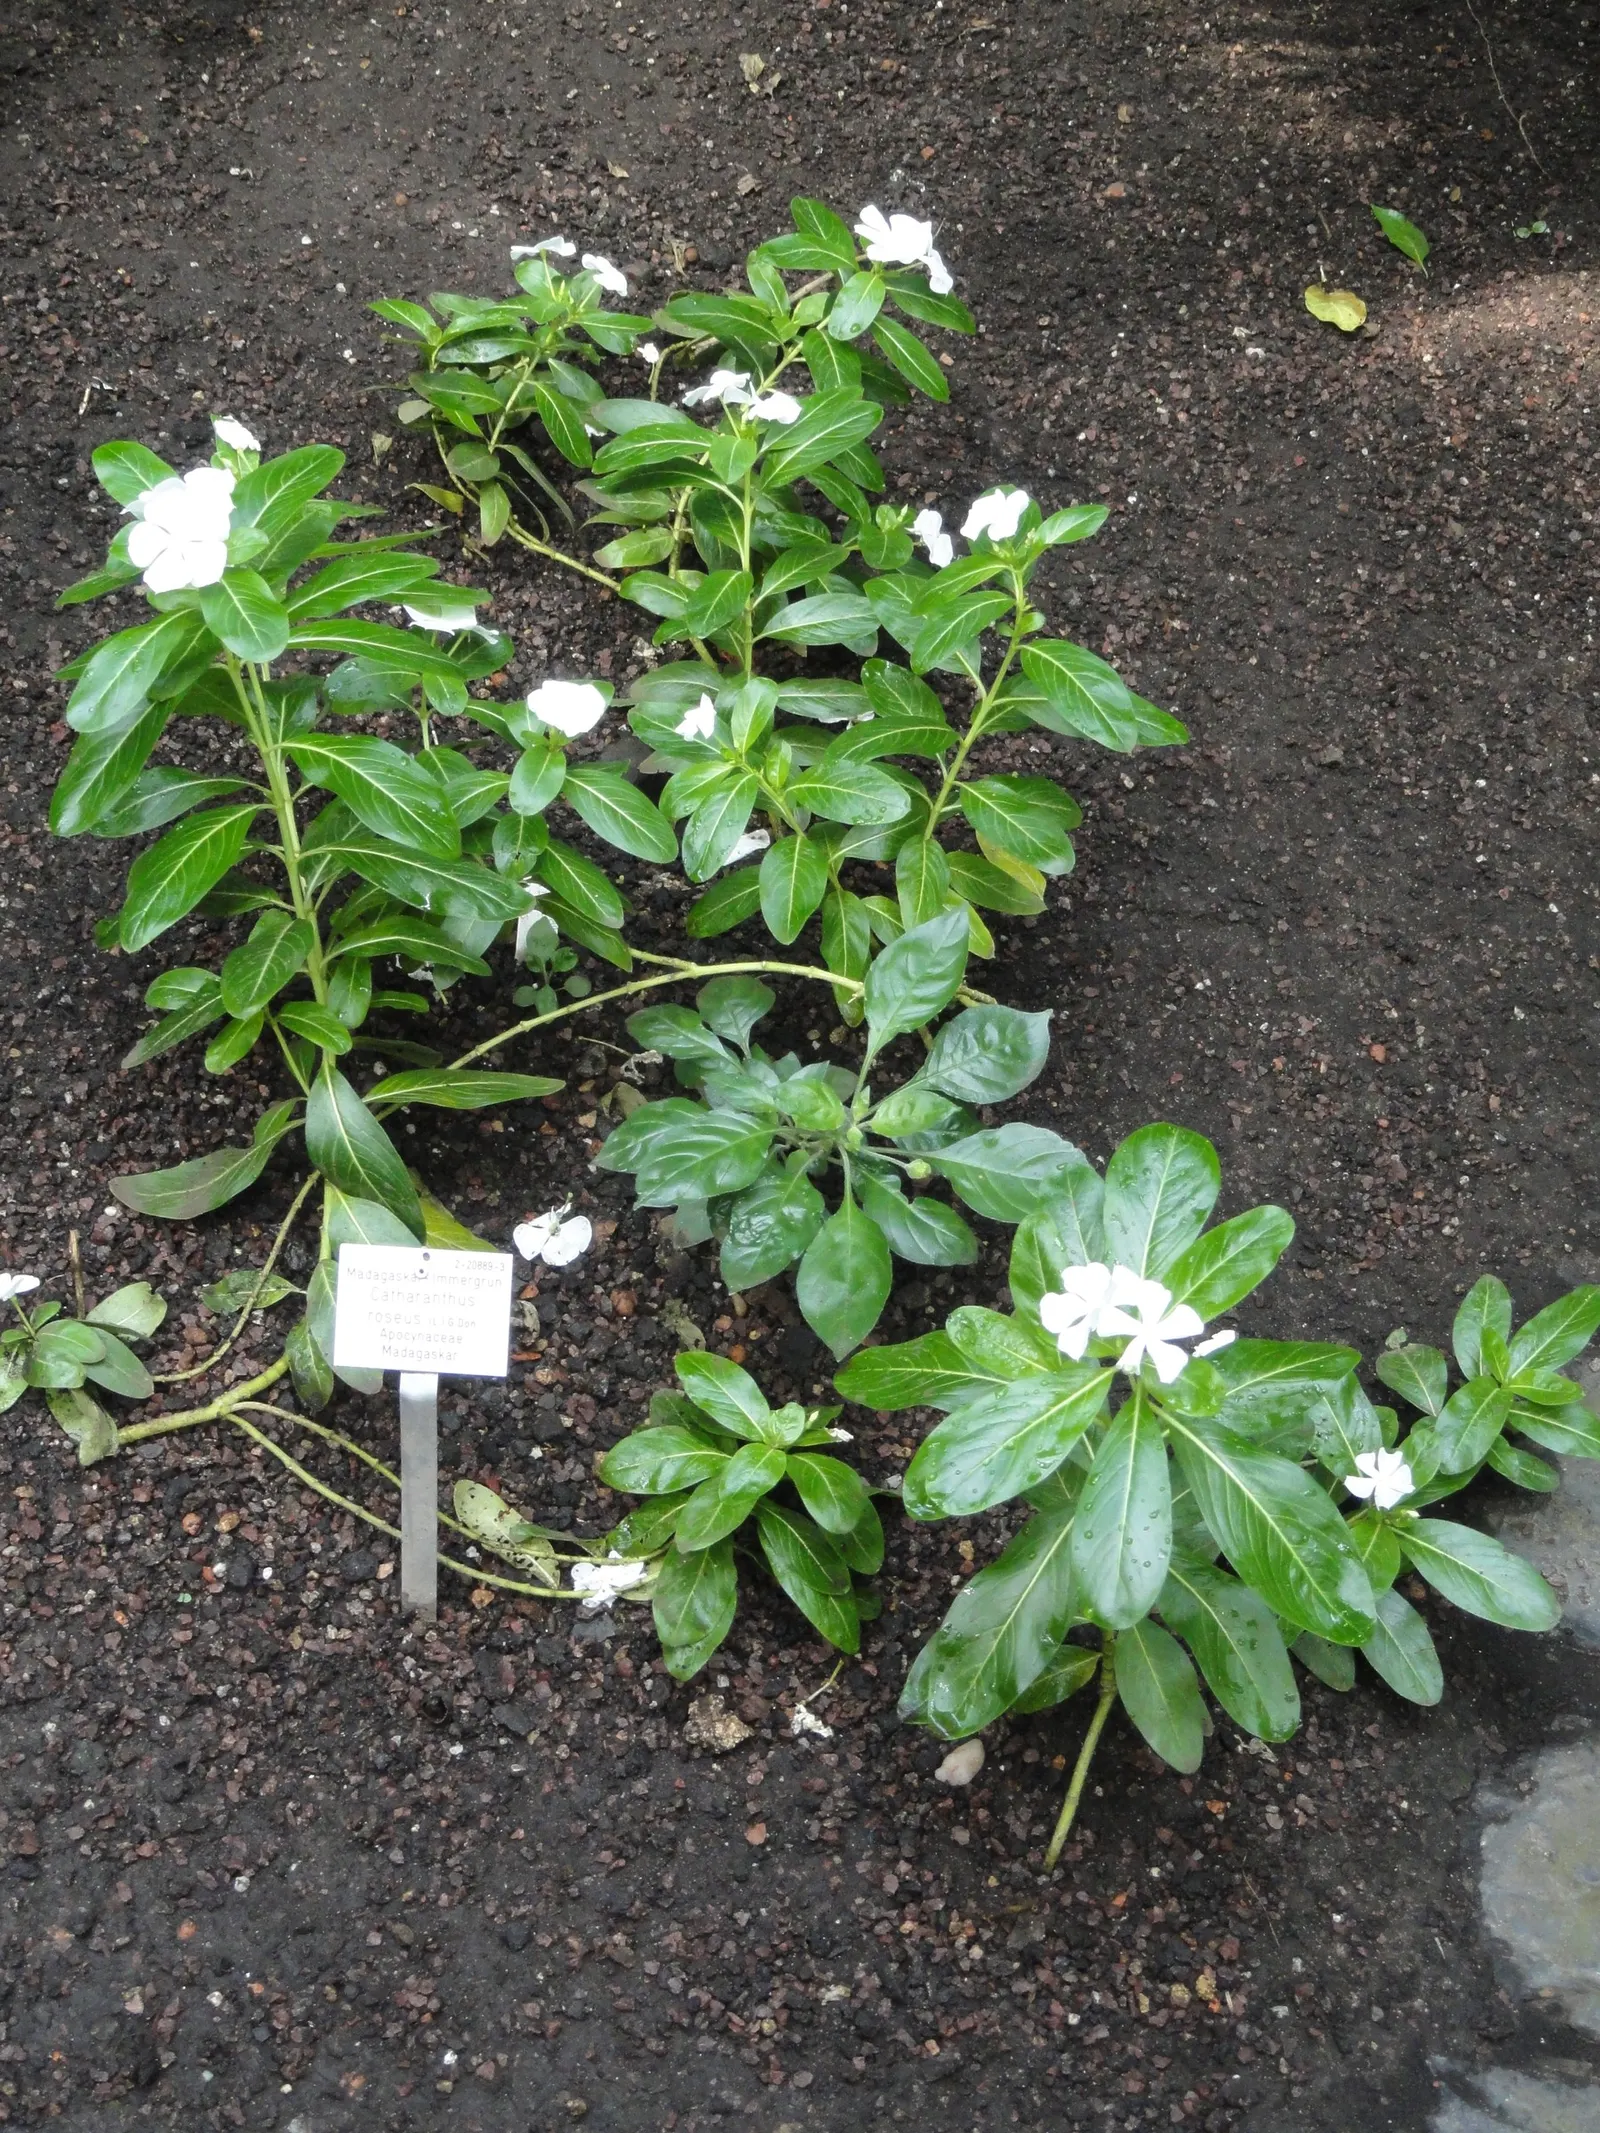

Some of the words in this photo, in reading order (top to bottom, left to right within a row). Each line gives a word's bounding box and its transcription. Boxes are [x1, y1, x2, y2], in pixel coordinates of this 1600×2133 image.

[370, 1286, 476, 1307] Catharanthus
[368, 1311, 421, 1325] roseus
[380, 1328, 463, 1344] Apocynaceae
[382, 1345, 459, 1362] Madagaskar
